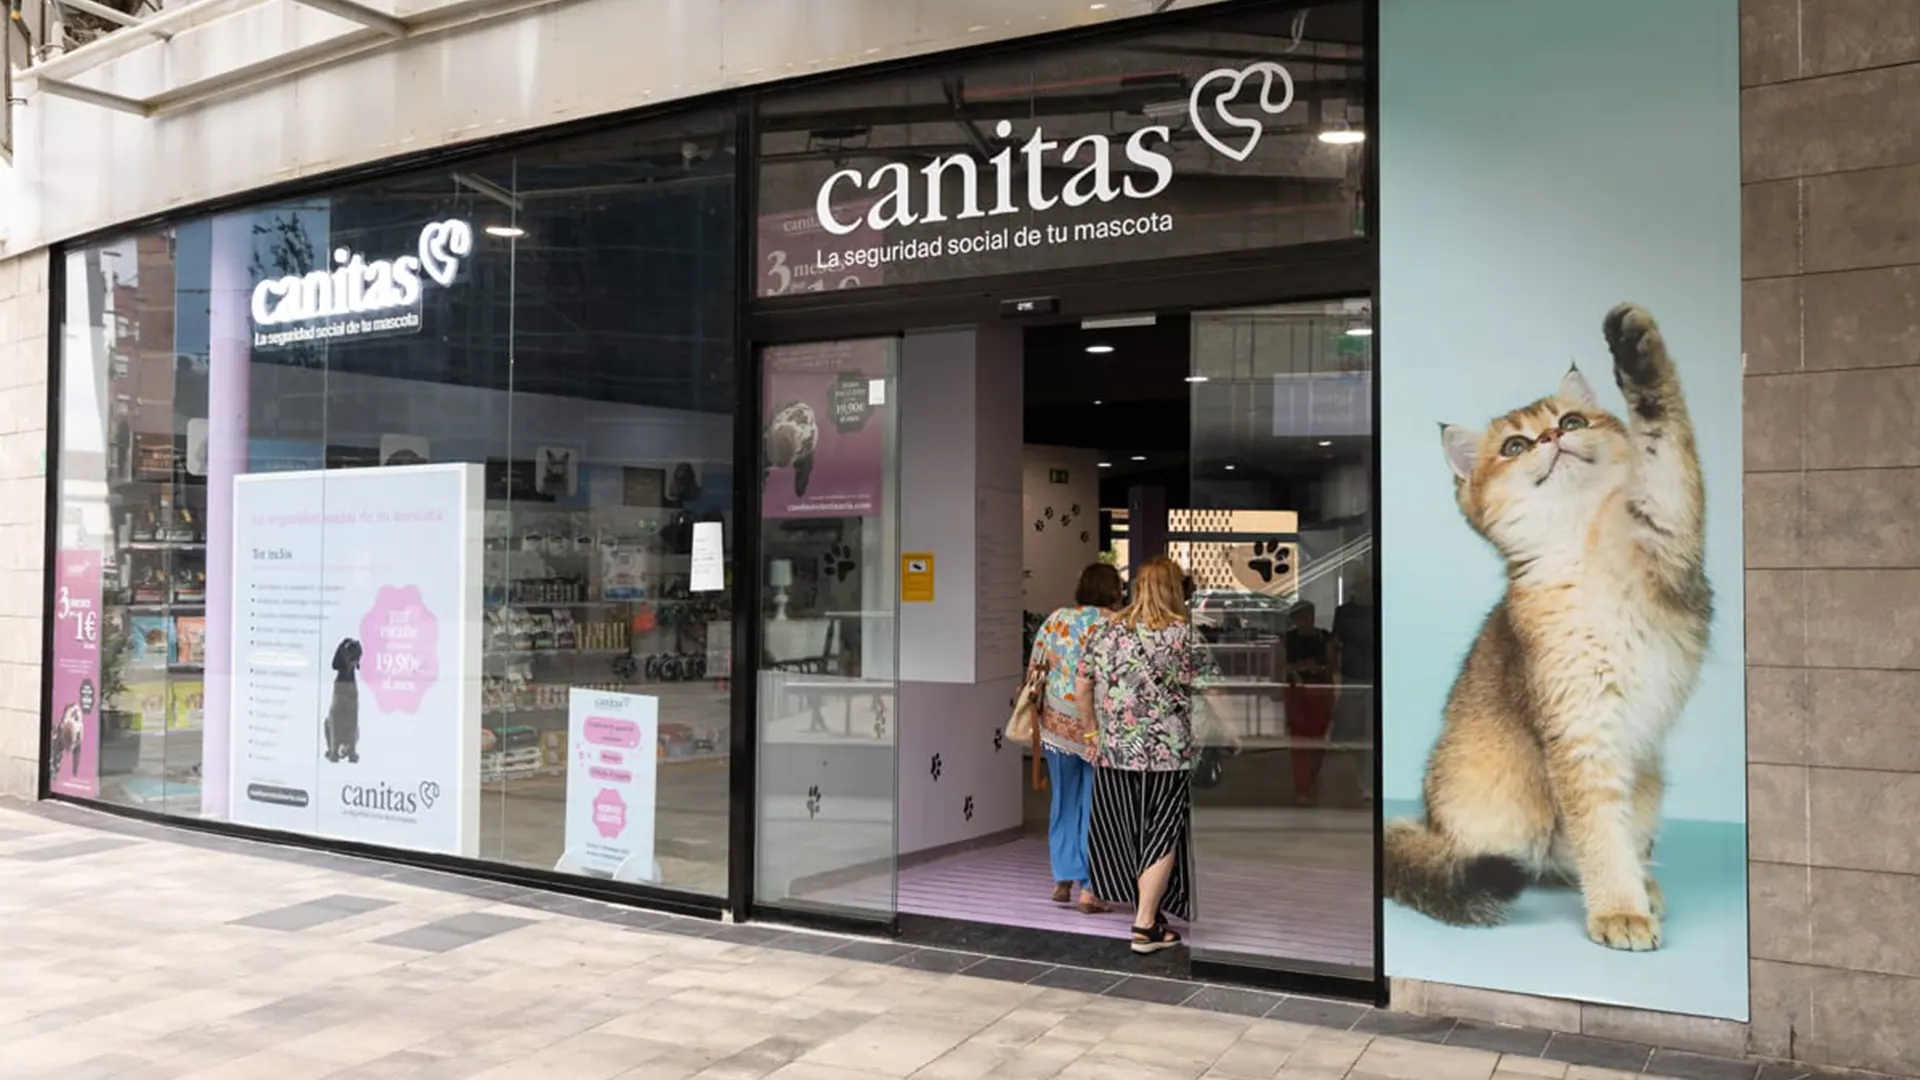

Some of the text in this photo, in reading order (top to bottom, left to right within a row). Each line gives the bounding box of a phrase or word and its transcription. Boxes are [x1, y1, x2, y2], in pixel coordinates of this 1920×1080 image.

[816, 119, 1173, 235] canitas
[817, 212, 1173, 268] La seguridad social de tu mascota
[251, 247, 421, 325] canitas
[767, 250, 791, 297] 3
[255, 313, 419, 346] La seguridad social de tu mascota
[58, 586, 70, 619] 3
[341, 781, 417, 813] canitas
